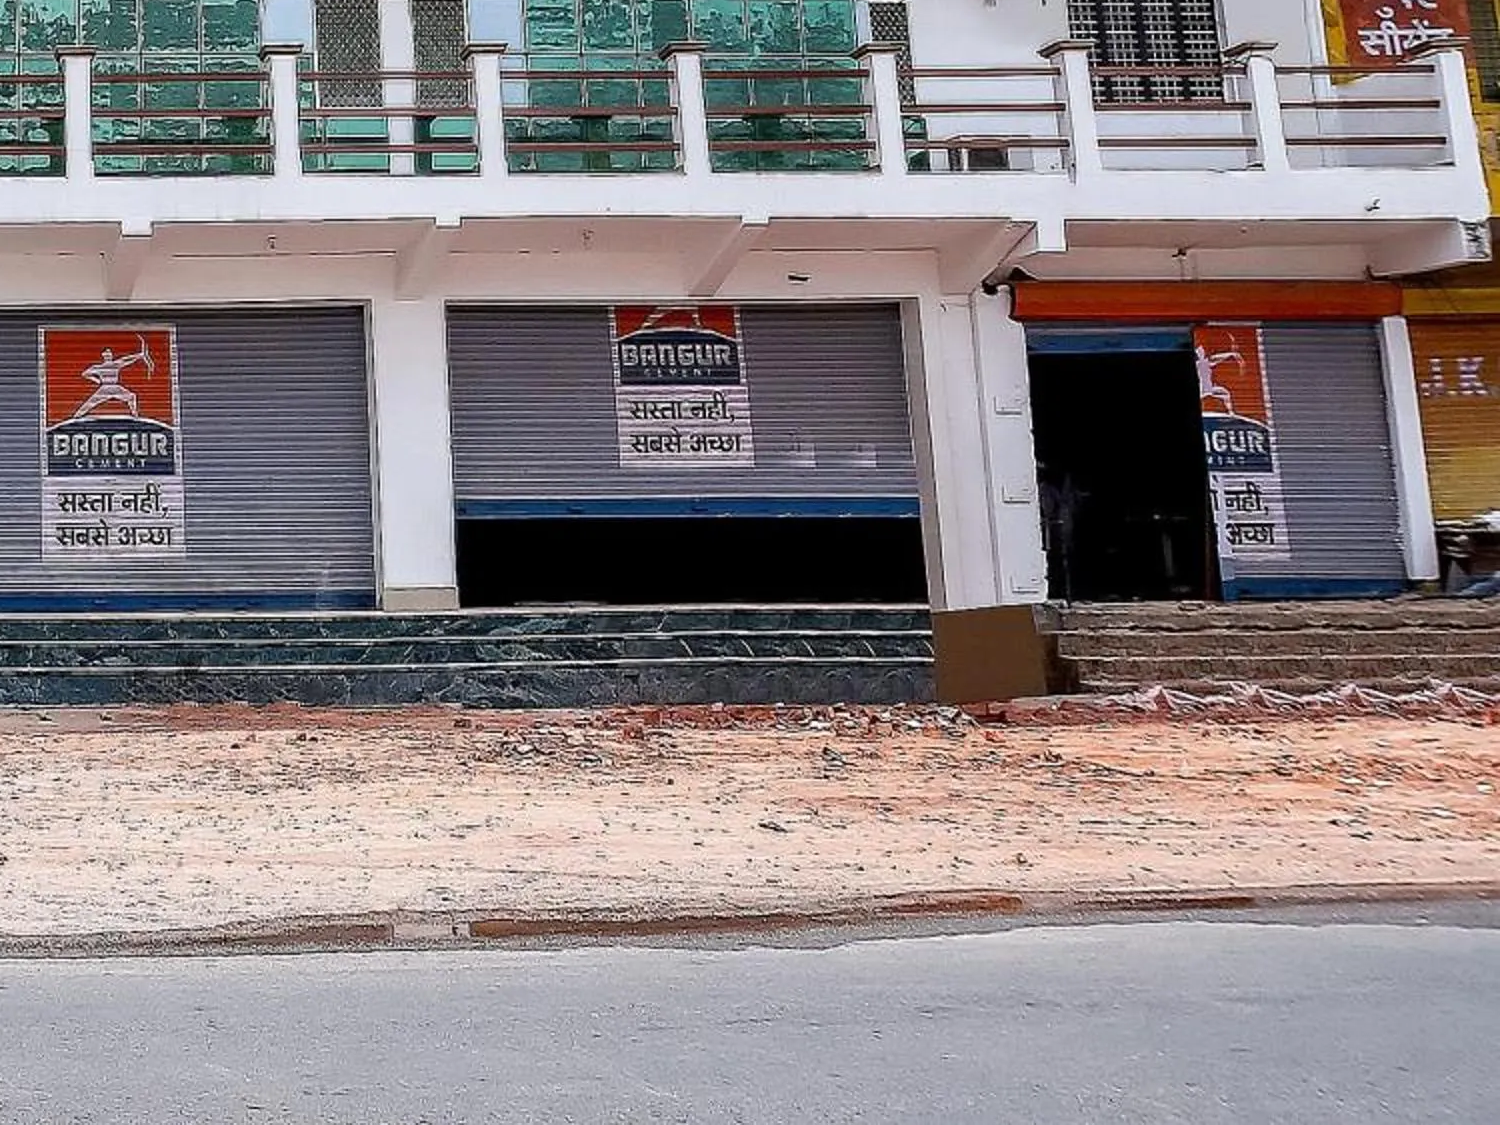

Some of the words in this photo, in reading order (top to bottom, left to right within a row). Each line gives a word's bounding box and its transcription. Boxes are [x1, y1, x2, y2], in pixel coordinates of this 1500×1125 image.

[620, 344, 734, 366] BANGUR
[628, 400, 683, 420] सस्ता
[52, 432, 169, 457] BANGUR
[629, 426, 682, 453] सबसे
[689, 434, 742, 453] अच्छा
[75, 458, 147, 468] CEMENT
[57, 492, 114, 513] सस्ता
[55, 518, 111, 547] सबसे
[118, 525, 174, 547] अच्छा
